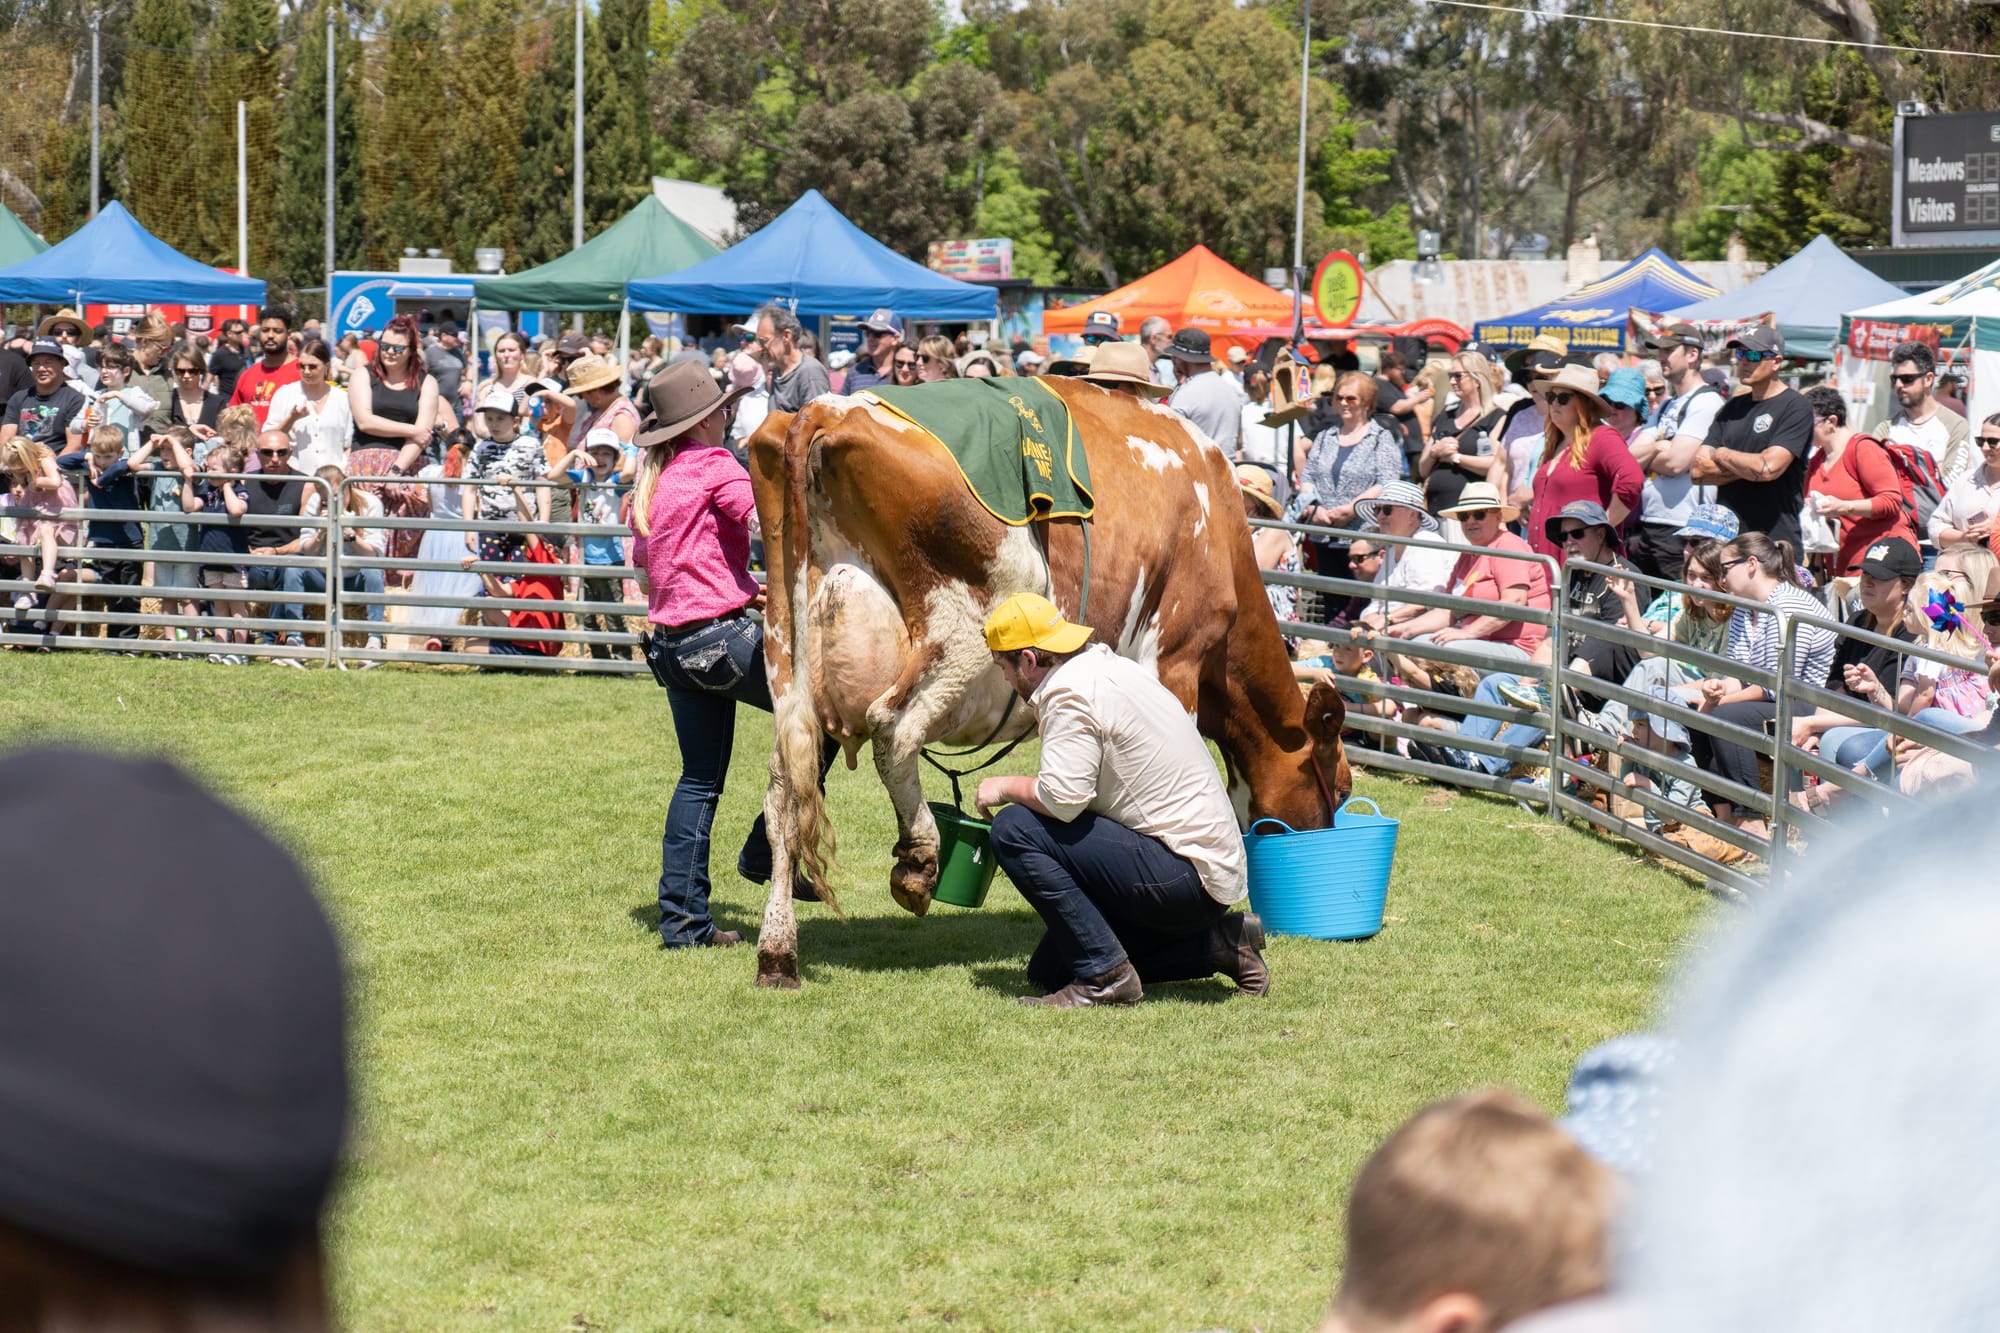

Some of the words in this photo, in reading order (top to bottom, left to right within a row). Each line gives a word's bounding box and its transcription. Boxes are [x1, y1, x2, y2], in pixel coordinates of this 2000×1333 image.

[1908, 156, 1965, 183] Meadows
[1908, 197, 1956, 223] Visitors
[188, 317, 211, 331] END
[1479, 326, 1509, 345] YOUR
[1510, 327, 1536, 345] FEEL
[1571, 327, 1620, 348] STATION
